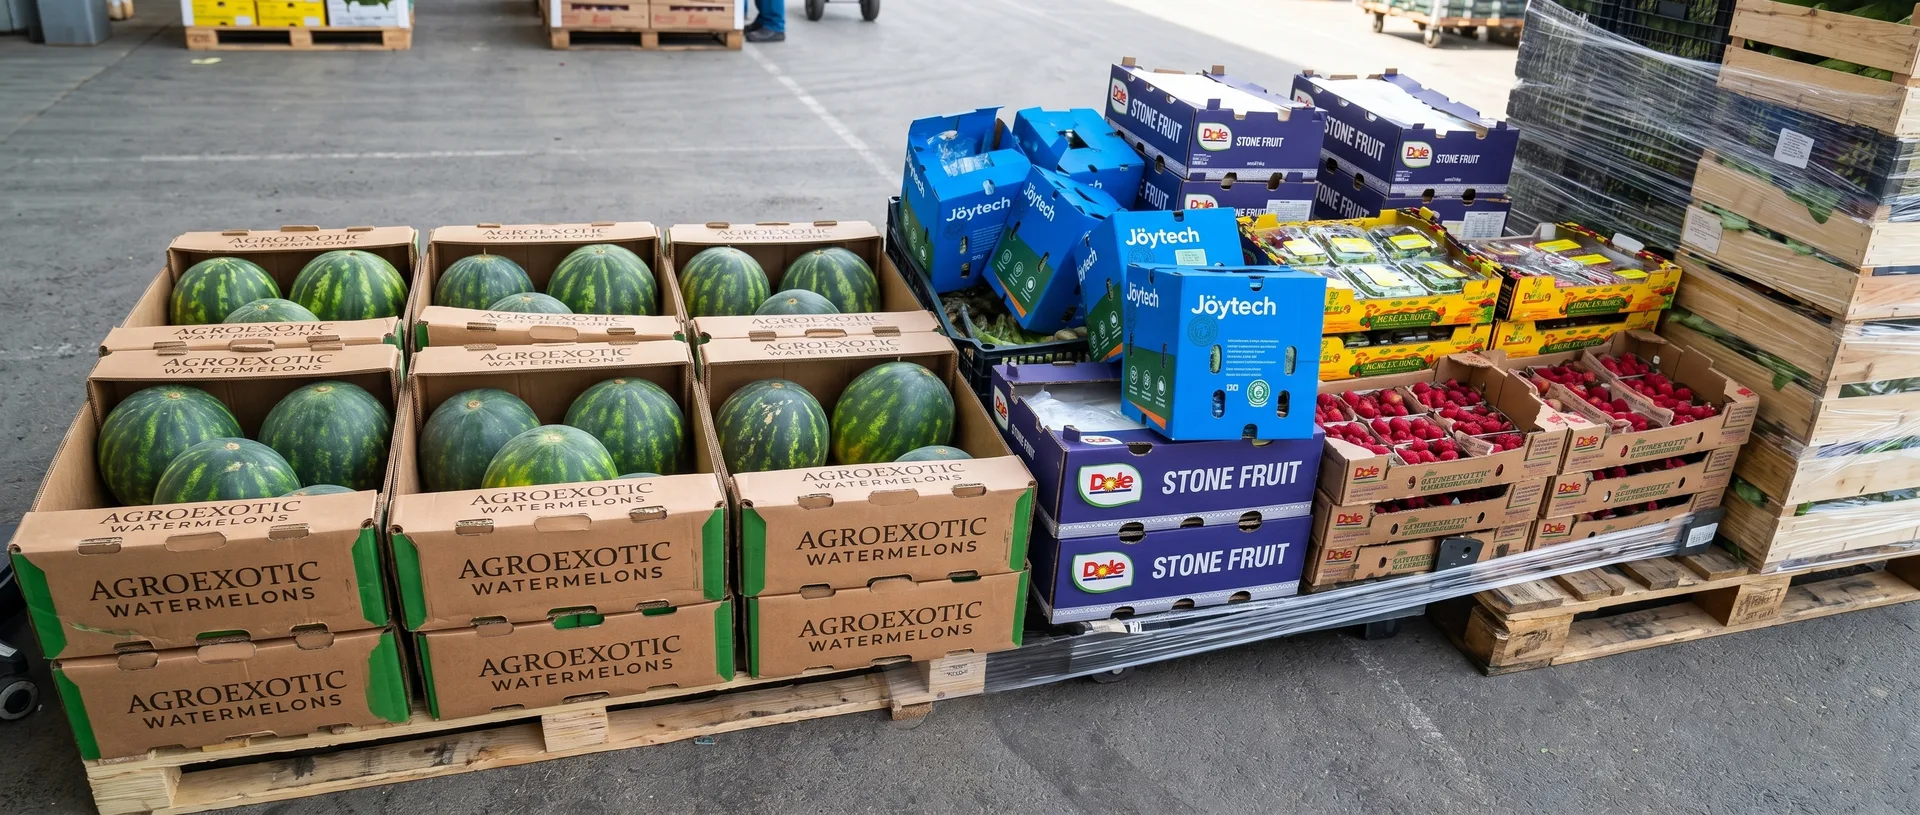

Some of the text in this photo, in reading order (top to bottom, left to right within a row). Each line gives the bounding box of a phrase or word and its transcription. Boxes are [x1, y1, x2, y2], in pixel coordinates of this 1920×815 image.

[1113, 86, 1127, 102] Dole
[1131, 98, 1182, 144] STONE FRUIT
[1203, 128, 1229, 141] Dole
[1236, 136, 1284, 147] STONE FRUIT
[1325, 115, 1386, 162] STONE FRUIT
[1407, 147, 1429, 158] Dole
[1436, 153, 1480, 164] STONE FRUIT
[1023, 182, 1055, 222] Jöytech
[1144, 182, 1170, 211] FRUIT
[1316, 183, 1340, 211] TONE
[946, 197, 1010, 222] Jöytech
[1246, 209, 1267, 217] FRUIT
[228, 233, 365, 244] AGROEXOTIC
[482, 227, 609, 236] AGROEXOTIC
[717, 227, 833, 236] AGROEXOTIC
[1126, 227, 1200, 249] Jöytech
[1127, 282, 1159, 309] Jöytech
[481, 312, 626, 322] AGROEXOTIC
[1191, 294, 1276, 320] Jöytech
[173, 323, 333, 336] AGROEXOTIC
[752, 315, 885, 325] AGROEXOTIC
[480, 348, 633, 362] AGROEXOTIC
[763, 339, 901, 351] AGROEXOTIC
[162, 354, 333, 367] AGROEXOTIC
[164, 364, 322, 375] WATERMELONS
[1575, 436, 1599, 449] Dole
[802, 463, 966, 483] AGROEXOTIC
[1089, 471, 1134, 492] Dole
[1162, 460, 1302, 495] STONE FRUIT
[1354, 465, 1380, 478] Dole
[815, 474, 962, 490] WATERMELONS
[1557, 482, 1581, 495] Dole
[470, 482, 653, 506] AGROEXOTIC
[99, 501, 302, 525] AGROEXOTIC
[480, 496, 646, 514] WATERMELONS
[110, 514, 290, 533] WATERMELONS
[1336, 512, 1363, 525] Dole
[796, 517, 987, 550] AGROEXOTIC
[1542, 523, 1566, 535] Dole
[458, 541, 672, 580] AGROEXOTIC
[807, 540, 978, 566] WATERMELONS
[1152, 543, 1290, 579] STONE FRUIT
[1325, 549, 1352, 561] Dole
[1082, 559, 1126, 579] Dole
[89, 561, 322, 601] AGROEXOTIC
[471, 566, 663, 596] WATERMELONS
[105, 587, 316, 619] WATERMELONS
[798, 601, 982, 638] AGROEXOTIC
[808, 623, 973, 652] WATERMELONS
[478, 635, 681, 678] AGROEXOTIC
[491, 658, 673, 692] WATERMELONS
[127, 670, 347, 714] AGROEXOTIC
[142, 694, 343, 730] WATERMELONS
